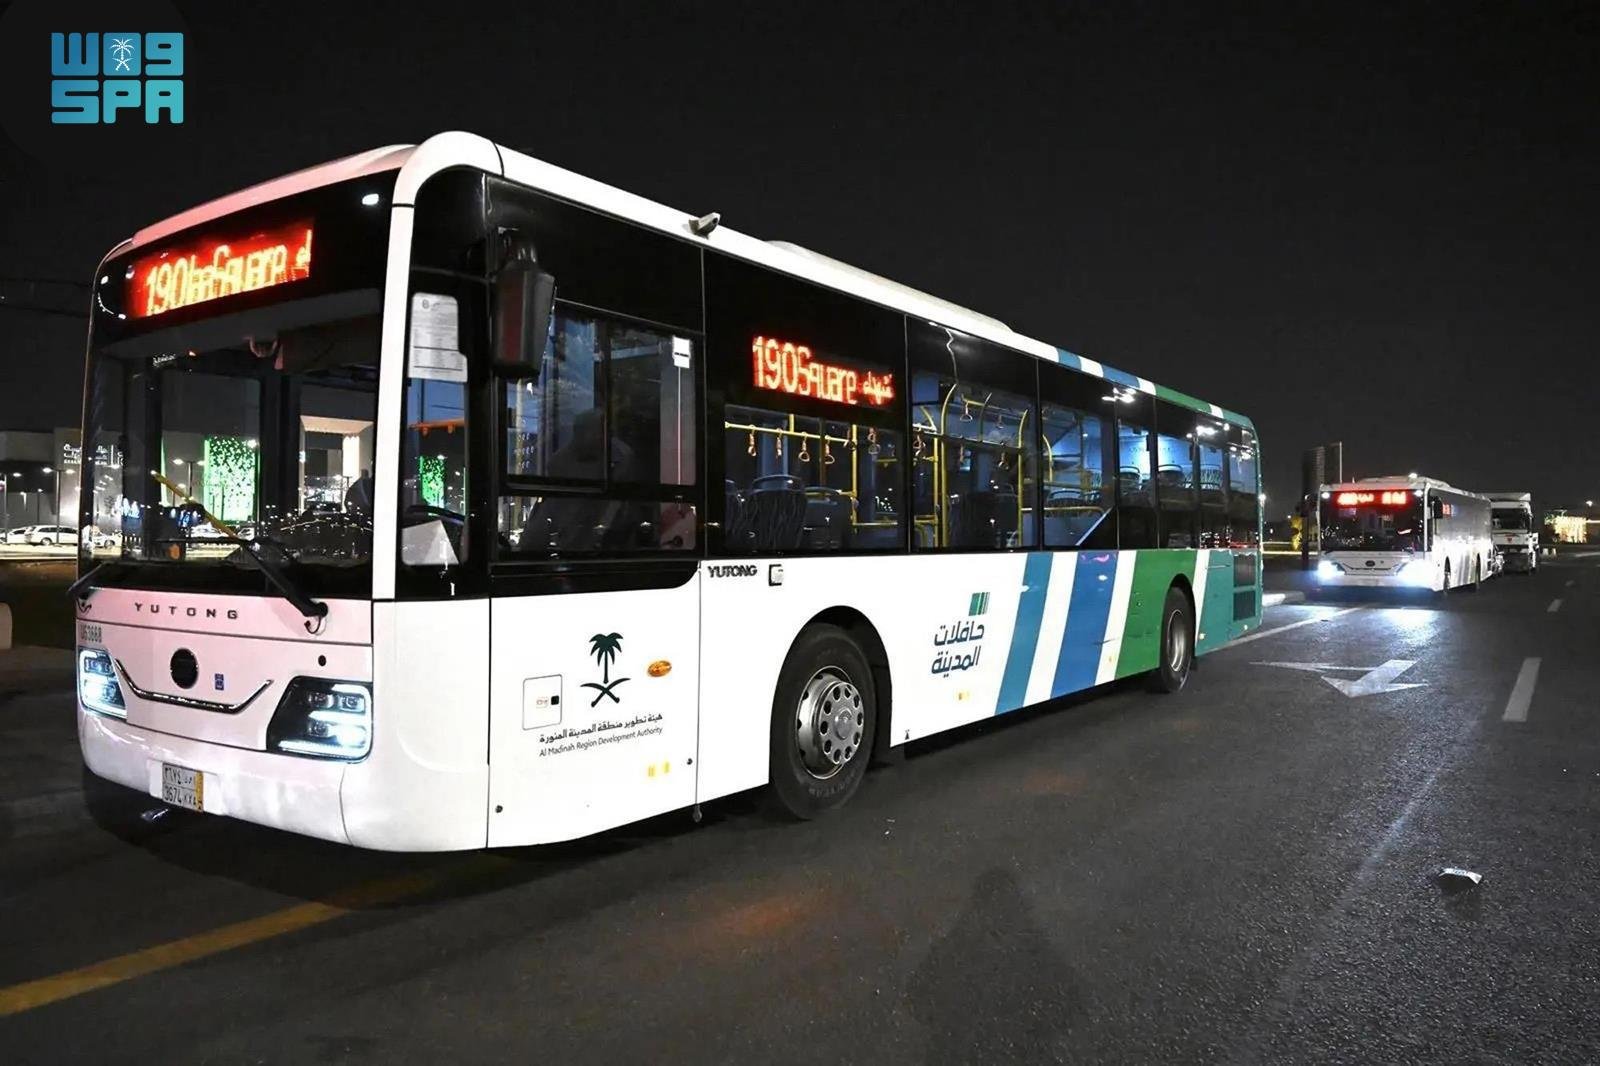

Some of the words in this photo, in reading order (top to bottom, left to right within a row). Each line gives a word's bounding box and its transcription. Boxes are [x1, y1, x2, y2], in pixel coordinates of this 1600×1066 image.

[706, 564, 758, 578] YUTONG
[134, 602, 239, 620] YUTONG
[934, 620, 985, 647] حافلات
[931, 645, 982, 678] المدينة
[624, 715, 647, 729] تطوير
[647, 713, 663, 723] هيئة
[568, 723, 597, 739] المدينة
[597, 720, 623, 732] منطقة
[539, 729, 568, 744] المنورة
[539, 748, 547, 757] Al
[547, 743, 576, 756] Madinah
[576, 738, 598, 751] Region
[598, 731, 636, 743] Development
[637, 727, 663, 737] Authority
